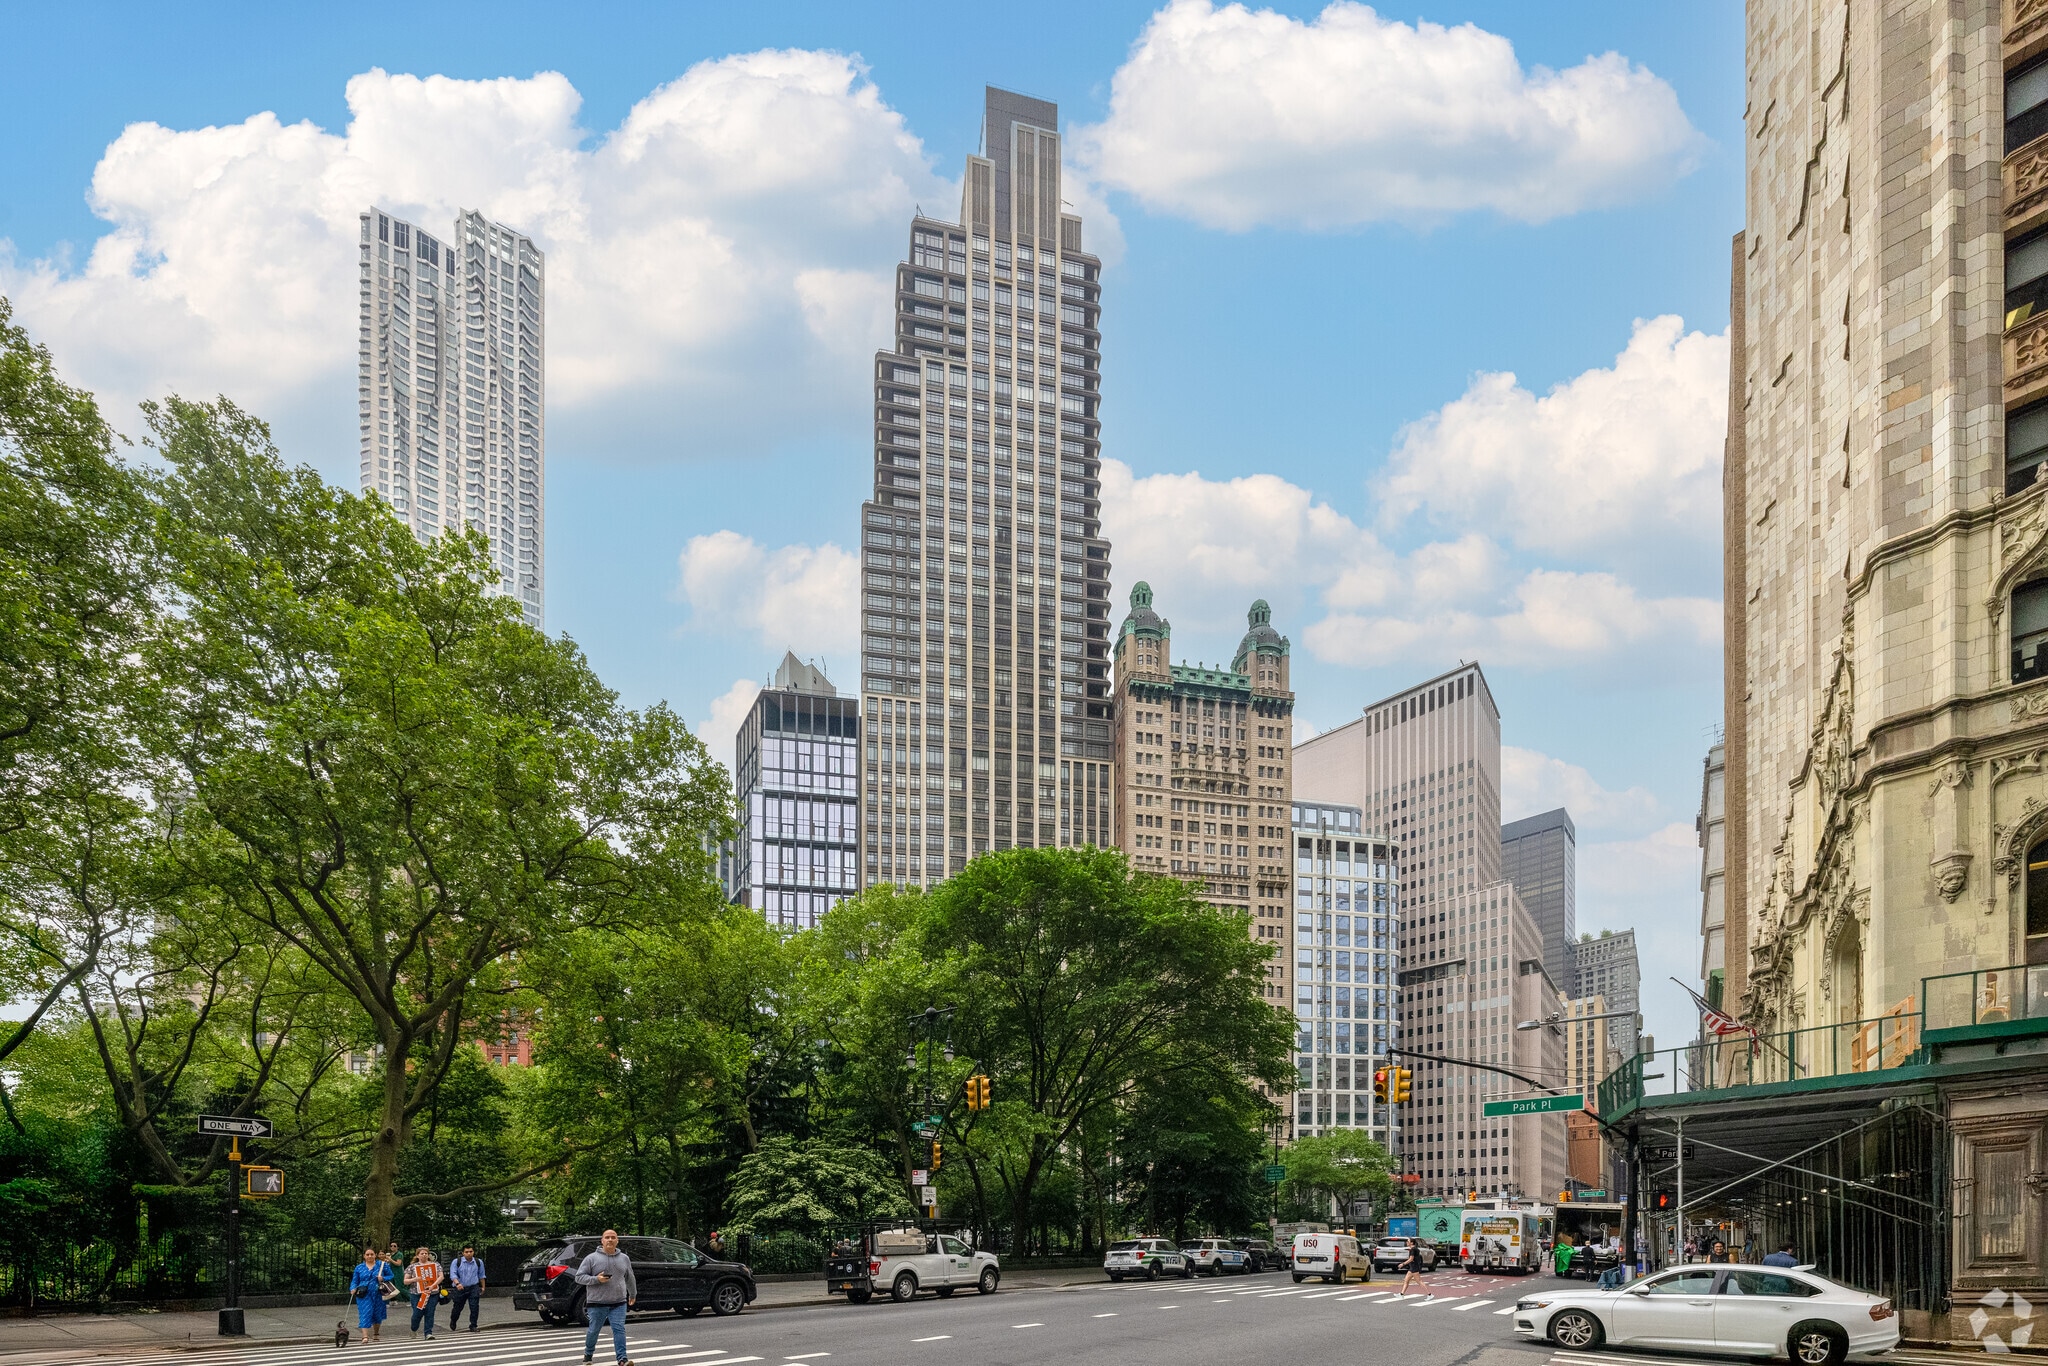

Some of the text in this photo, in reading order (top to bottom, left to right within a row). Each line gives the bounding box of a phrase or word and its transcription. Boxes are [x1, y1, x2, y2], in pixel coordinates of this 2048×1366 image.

[1513, 1100, 1551, 1112] Park Pl
[209, 1121, 261, 1132] ONE WAY
[1662, 1150, 1678, 1158] Par
[1303, 1239, 1318, 1249] USQ
[1165, 1256, 1181, 1264] NYPD
